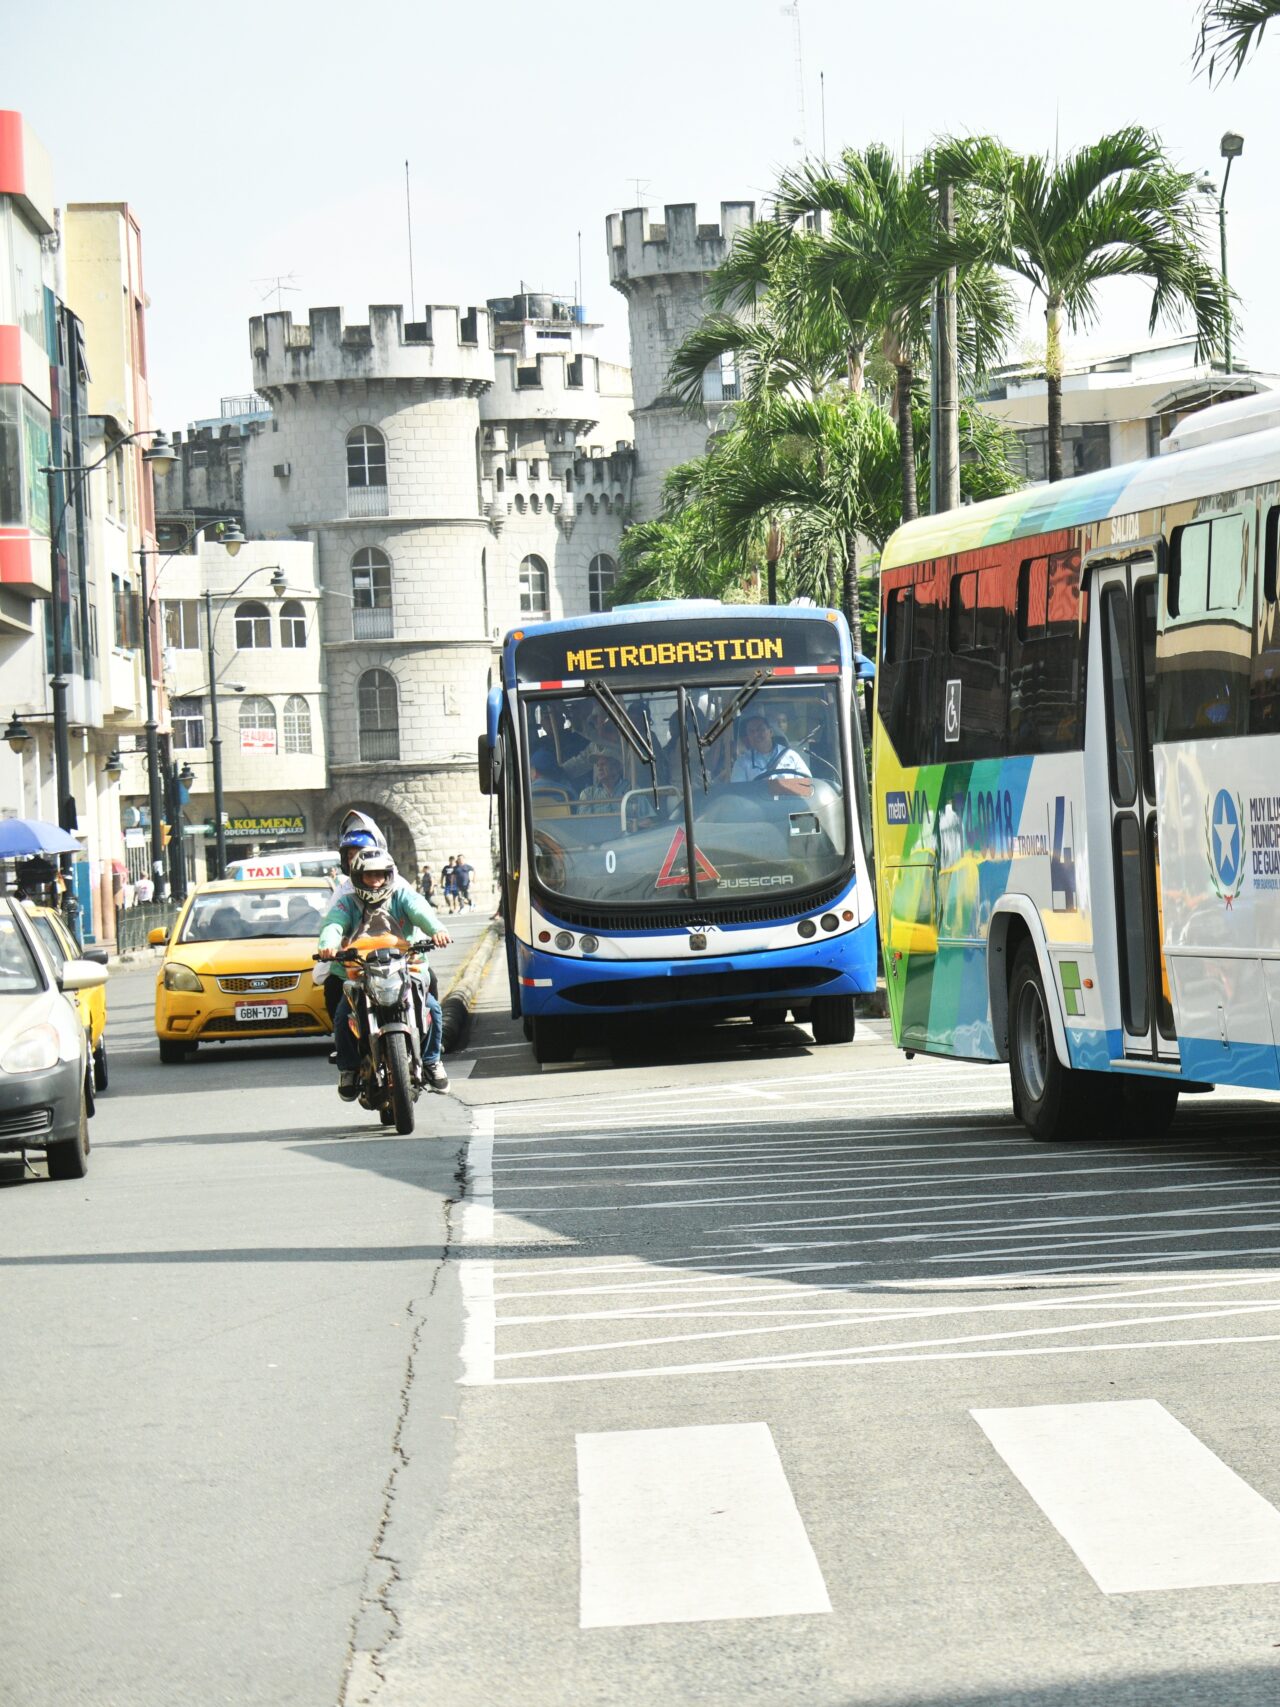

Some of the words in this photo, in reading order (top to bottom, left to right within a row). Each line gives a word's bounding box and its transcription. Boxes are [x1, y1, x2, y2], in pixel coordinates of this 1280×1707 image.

[1111, 512, 1140, 544] SALIDA
[566, 638, 784, 672] METROBASTION
[1250, 797, 1266, 823] MUY
[260, 826, 305, 835] NATURALES
[1017, 834, 1049, 856] TRONCAL
[246, 866, 281, 878] TAXI
[1252, 850, 1264, 875] DE
[692, 925, 717, 933] VIA
[240, 1006, 283, 1020] GBN-1797
